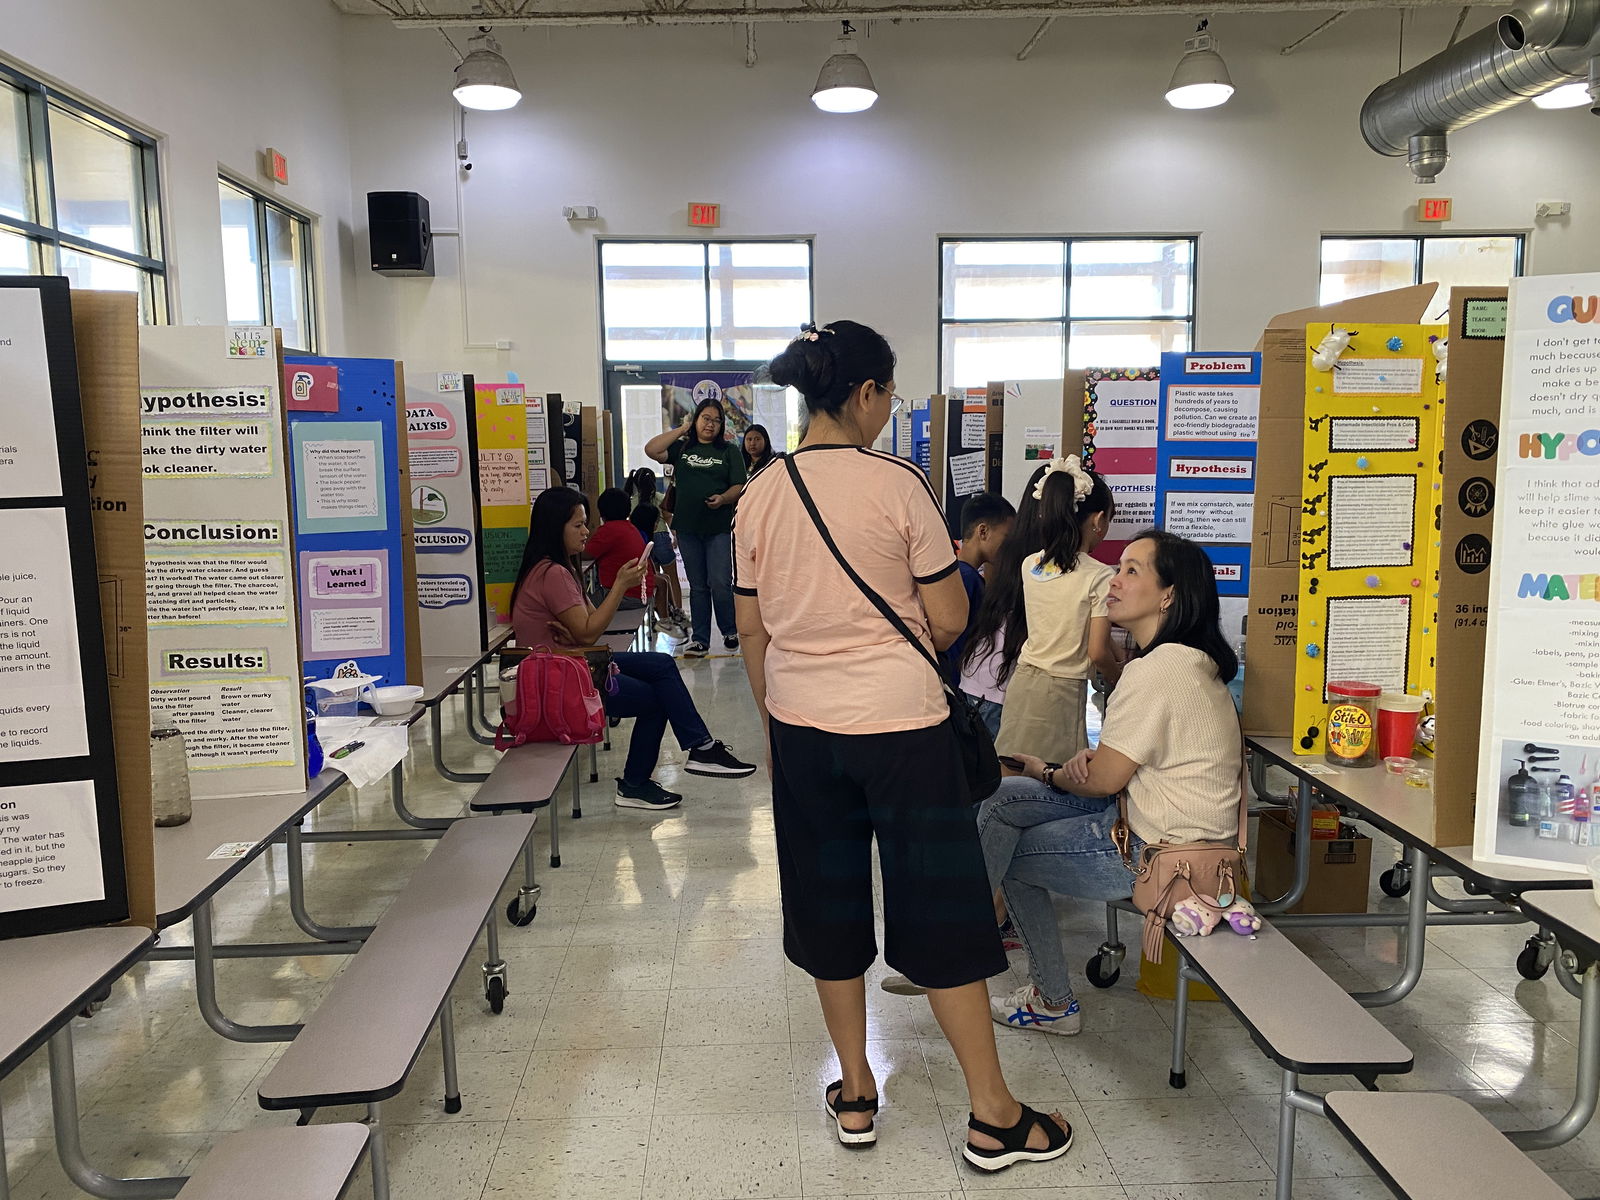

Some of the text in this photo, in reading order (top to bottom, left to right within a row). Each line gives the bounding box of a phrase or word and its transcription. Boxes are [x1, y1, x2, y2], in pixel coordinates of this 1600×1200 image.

[1425, 200, 1449, 219] EXIT
[692, 205, 717, 225] EXIT
[1543, 338, 1590, 347] don't get
[1529, 351, 1600, 361] much because
[1190, 361, 1246, 371] Problem
[1531, 365, 1580, 375] and dries
[1542, 379, 1571, 388] make
[140, 392, 267, 412] ypothesis:
[1529, 392, 1587, 402] doesn't dry
[1532, 406, 1561, 416] much,
[175, 426, 196, 437] the
[200, 425, 231, 436] filter
[235, 425, 259, 435] will
[408, 421, 448, 431] ALYSIS
[142, 444, 267, 457] ake the dirty water
[164, 463, 218, 473] cleaner.
[1175, 464, 1247, 475] Hypothesis
[1538, 493, 1589, 503] help slime
[1519, 506, 1590, 517] keep easier
[1562, 520, 1585, 530] glue
[144, 524, 278, 540] Conclusion:
[1527, 533, 1570, 542] because
[327, 580, 367, 589] Learned
[6, 607, 30, 617] liquid
[1455, 604, 1469, 614] 36
[1454, 618, 1477, 629] (91.4
[16, 640, 40, 650] liquid
[14, 651, 51, 661] amount.
[168, 653, 263, 669] Results:
[1537, 679, 1567, 688] Elmer's,
[1333, 710, 1366, 725] Stik-O
[20, 726, 48, 735] record
[1544, 722, 1579, 731] coloring,
[11, 739, 42, 748] liquids.
[35, 854, 56, 864] juice
